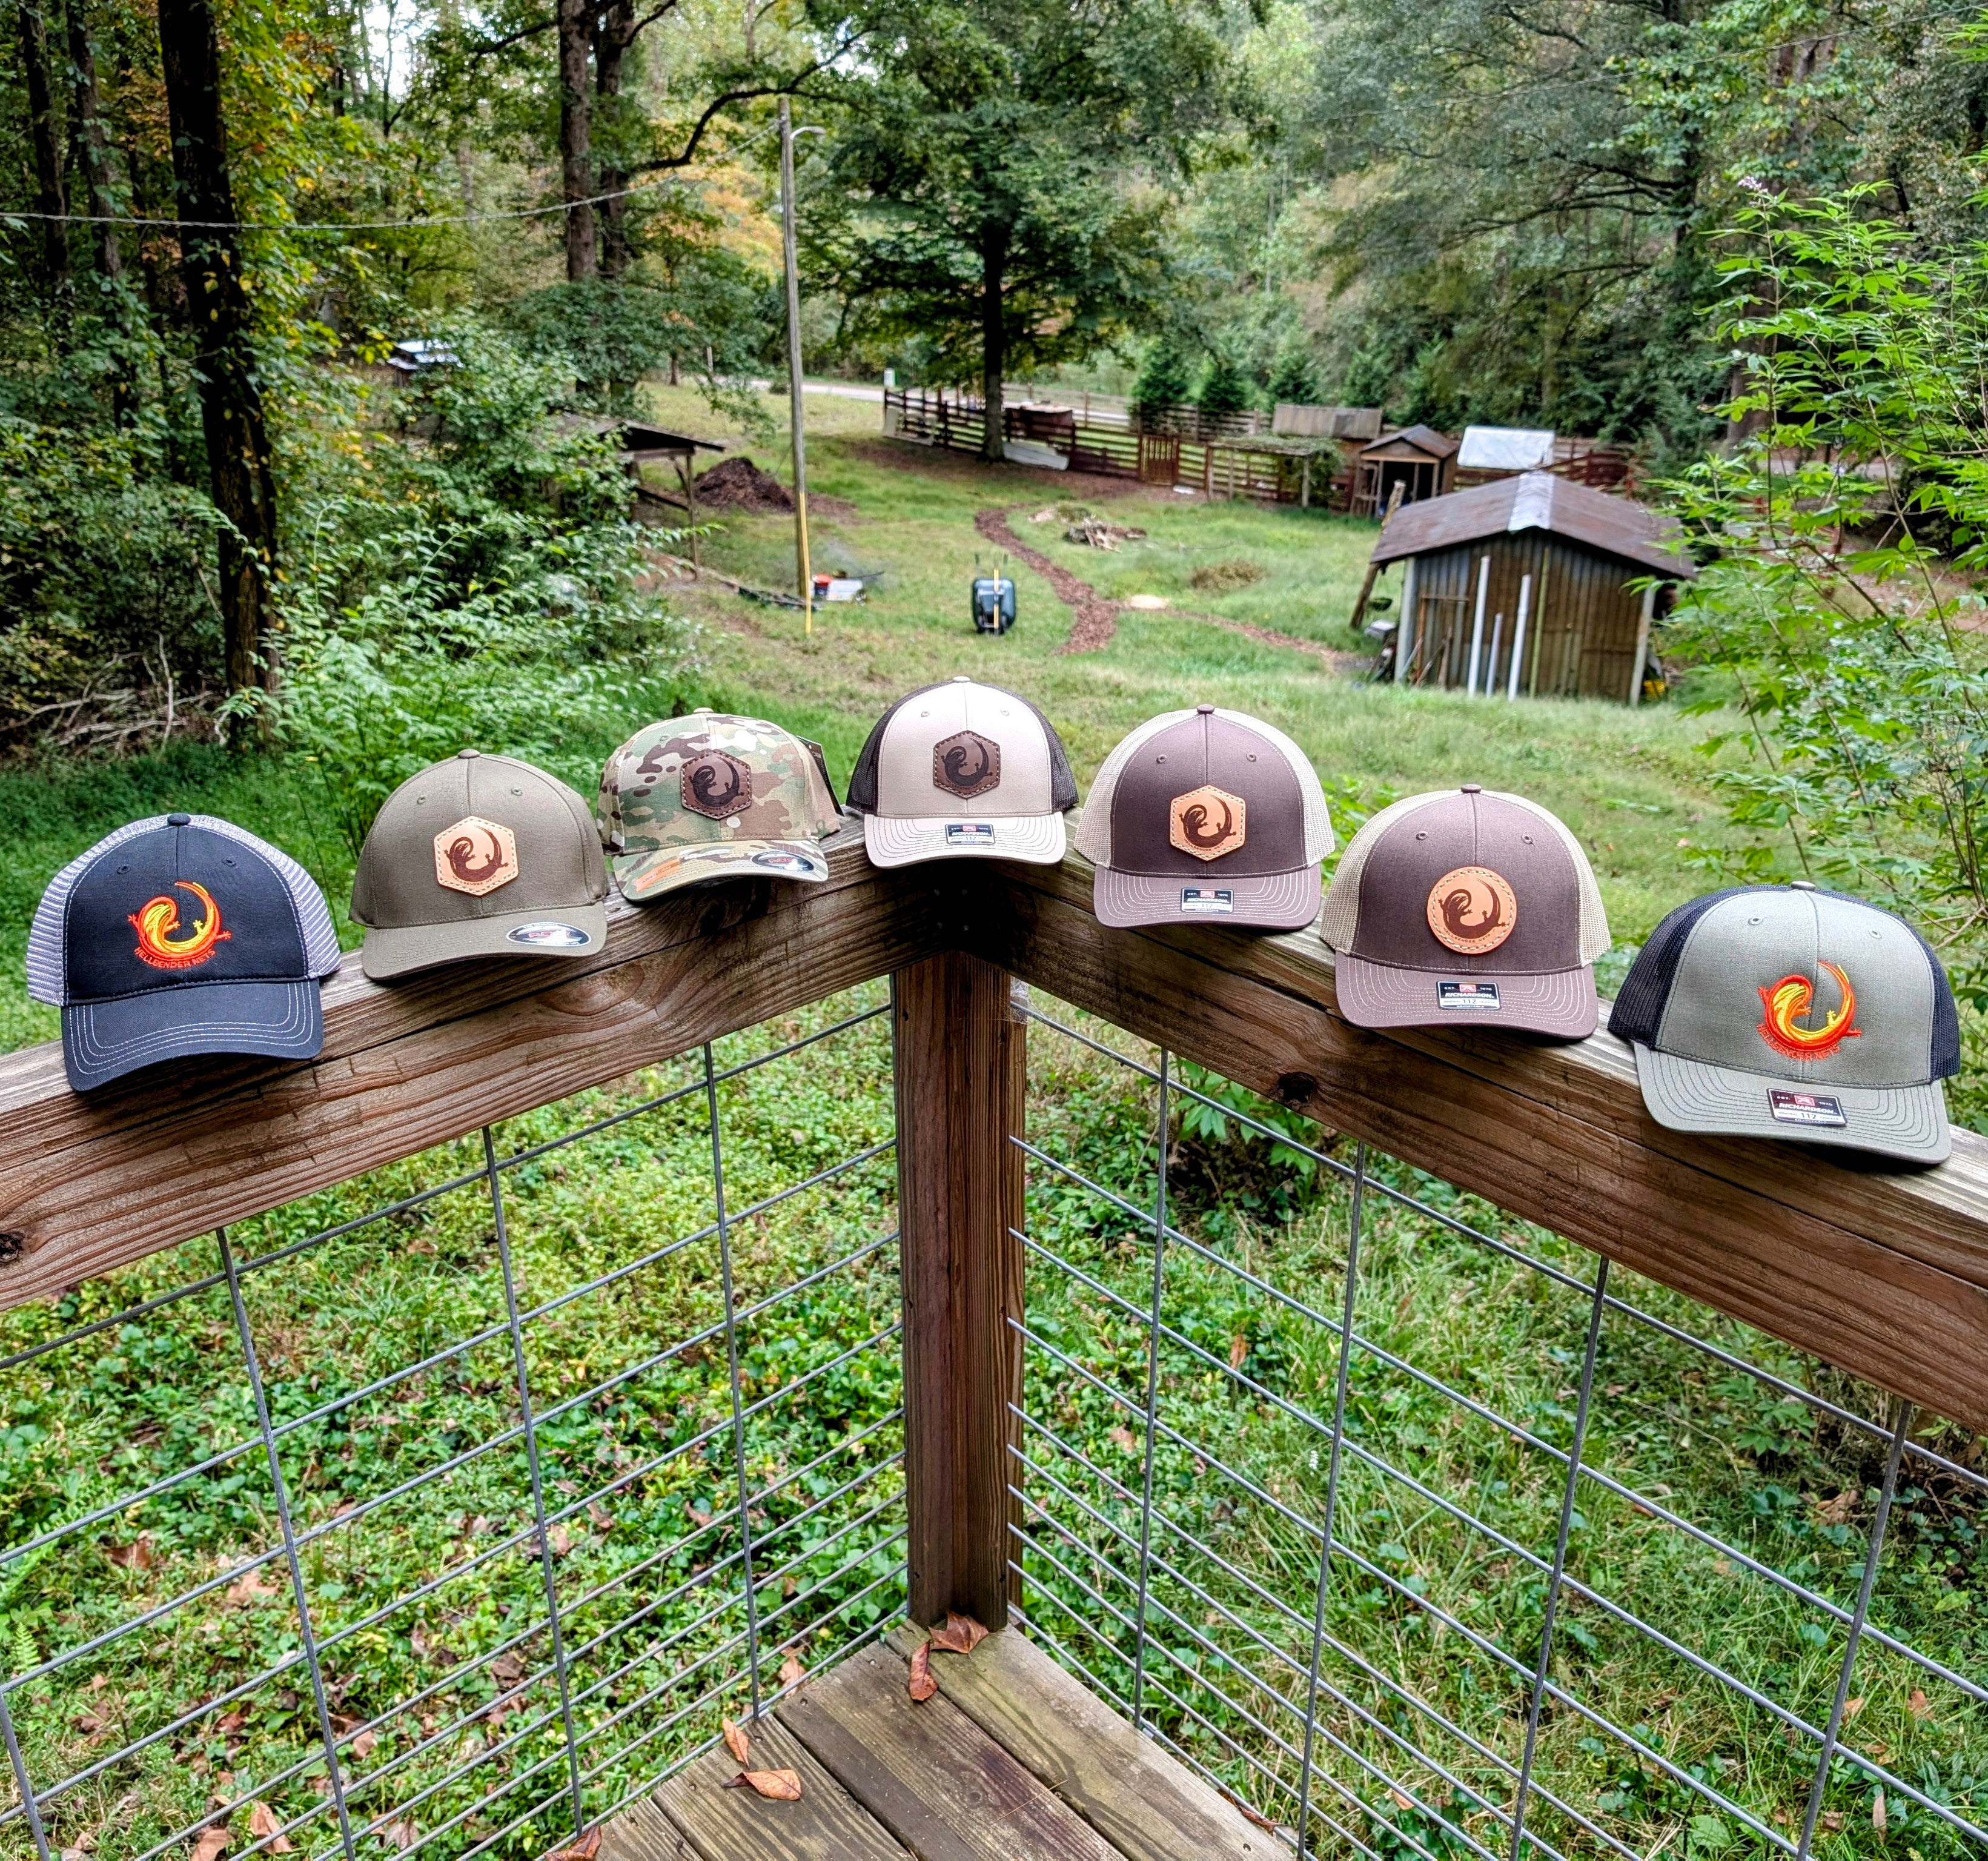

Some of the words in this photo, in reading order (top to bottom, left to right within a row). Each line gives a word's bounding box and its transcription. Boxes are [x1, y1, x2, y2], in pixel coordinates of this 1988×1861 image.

[134, 946, 191, 968] HELLBENDER
[191, 949, 216, 965] NETS
[1779, 1103, 1834, 1115] RICHARDSON
